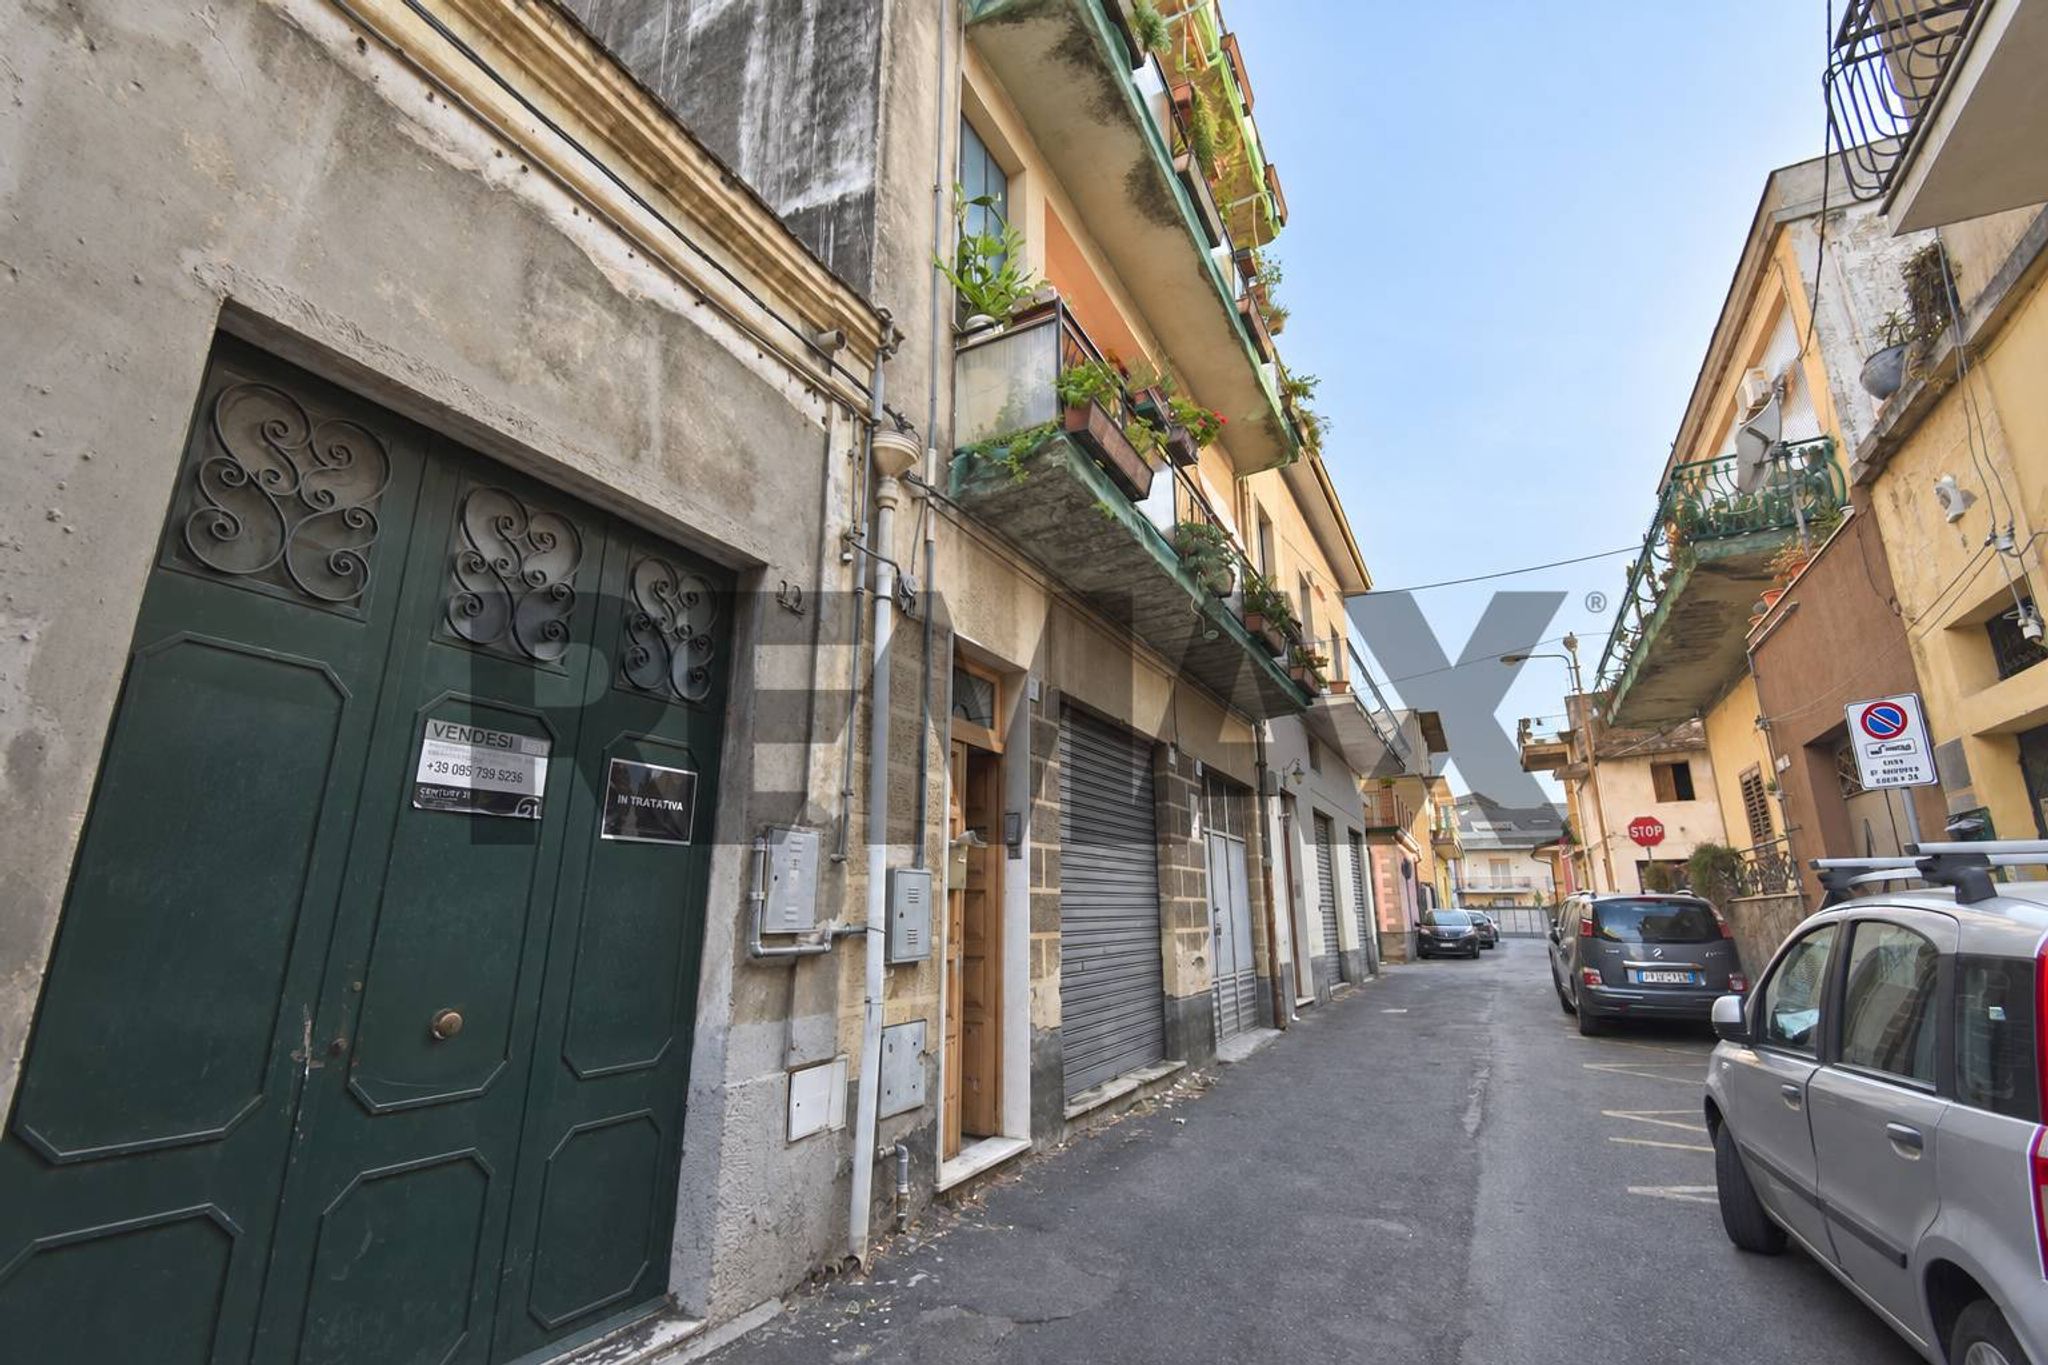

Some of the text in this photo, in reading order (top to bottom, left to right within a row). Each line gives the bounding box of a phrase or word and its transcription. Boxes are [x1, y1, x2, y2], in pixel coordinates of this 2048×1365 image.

[433, 722, 514, 749] VENDESI
[426, 761, 449, 774] +39
[451, 763, 472, 777] 095
[476, 766, 495, 781] 799
[617, 794, 684, 812] IN TRATATIVA
[1630, 825, 1663, 838] STOP
